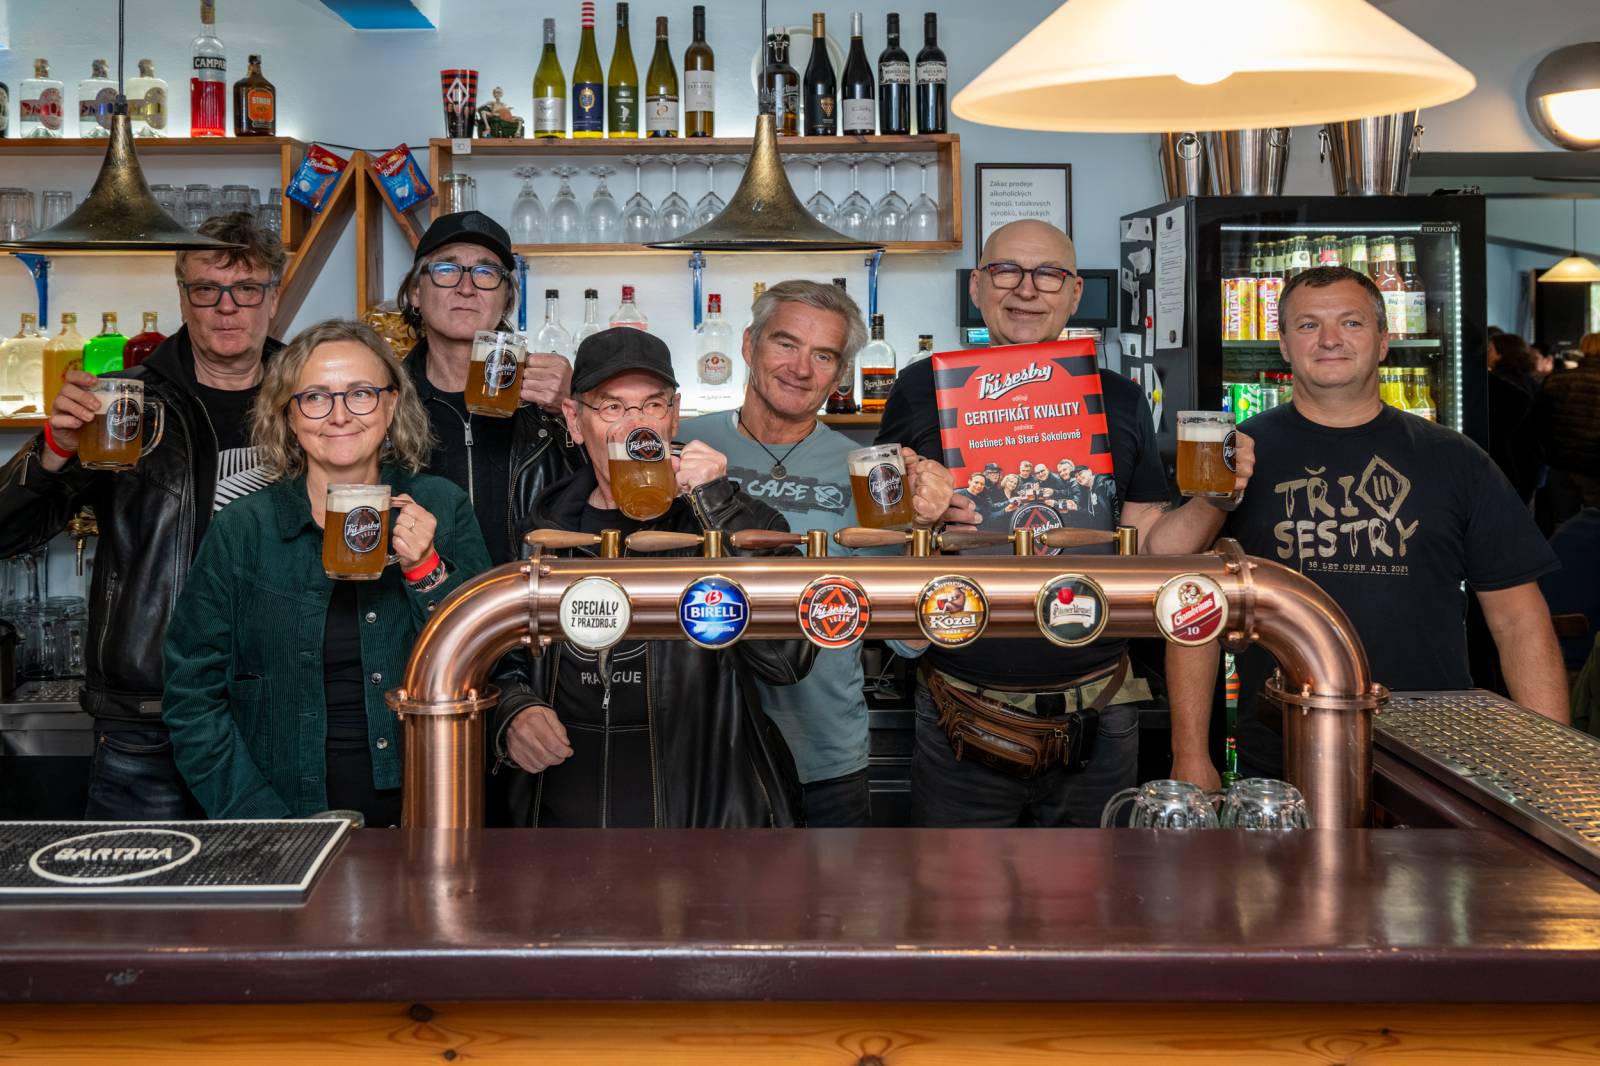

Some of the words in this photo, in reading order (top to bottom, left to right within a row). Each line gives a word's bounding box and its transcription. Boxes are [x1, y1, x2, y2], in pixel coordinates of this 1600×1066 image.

[976, 373, 1002, 400] Tři
[1003, 362, 1053, 389] sestry
[964, 403, 1031, 426] CERTIFIKÁT
[1033, 401, 1081, 419] KVALITY
[968, 438, 1004, 450] Hostinec
[1005, 436, 1017, 446] Na
[1018, 432, 1040, 445] Staré
[1041, 428, 1081, 443] Sokolovně
[746, 479, 811, 501] CAUSE
[1274, 466, 1360, 519] TŘI
[1273, 517, 1420, 560] SESTRY
[1308, 561, 1318, 569] 38
[1322, 562, 1339, 570] LET
[1343, 563, 1366, 571] OPEN
[1370, 564, 1387, 572] AIR
[571, 598, 619, 616] SPECIÁLY
[690, 606, 737, 618] BIRELL
[1174, 598, 1214, 627] Gambrinus
[571, 617, 576, 628] Z
[577, 617, 617, 629] PRAZDROJE
[928, 613, 977, 630] Kozel
[1187, 626, 1200, 636] 10
[580, 671, 642, 685] PRAGUE
[54, 847, 173, 861] BARTIDA
